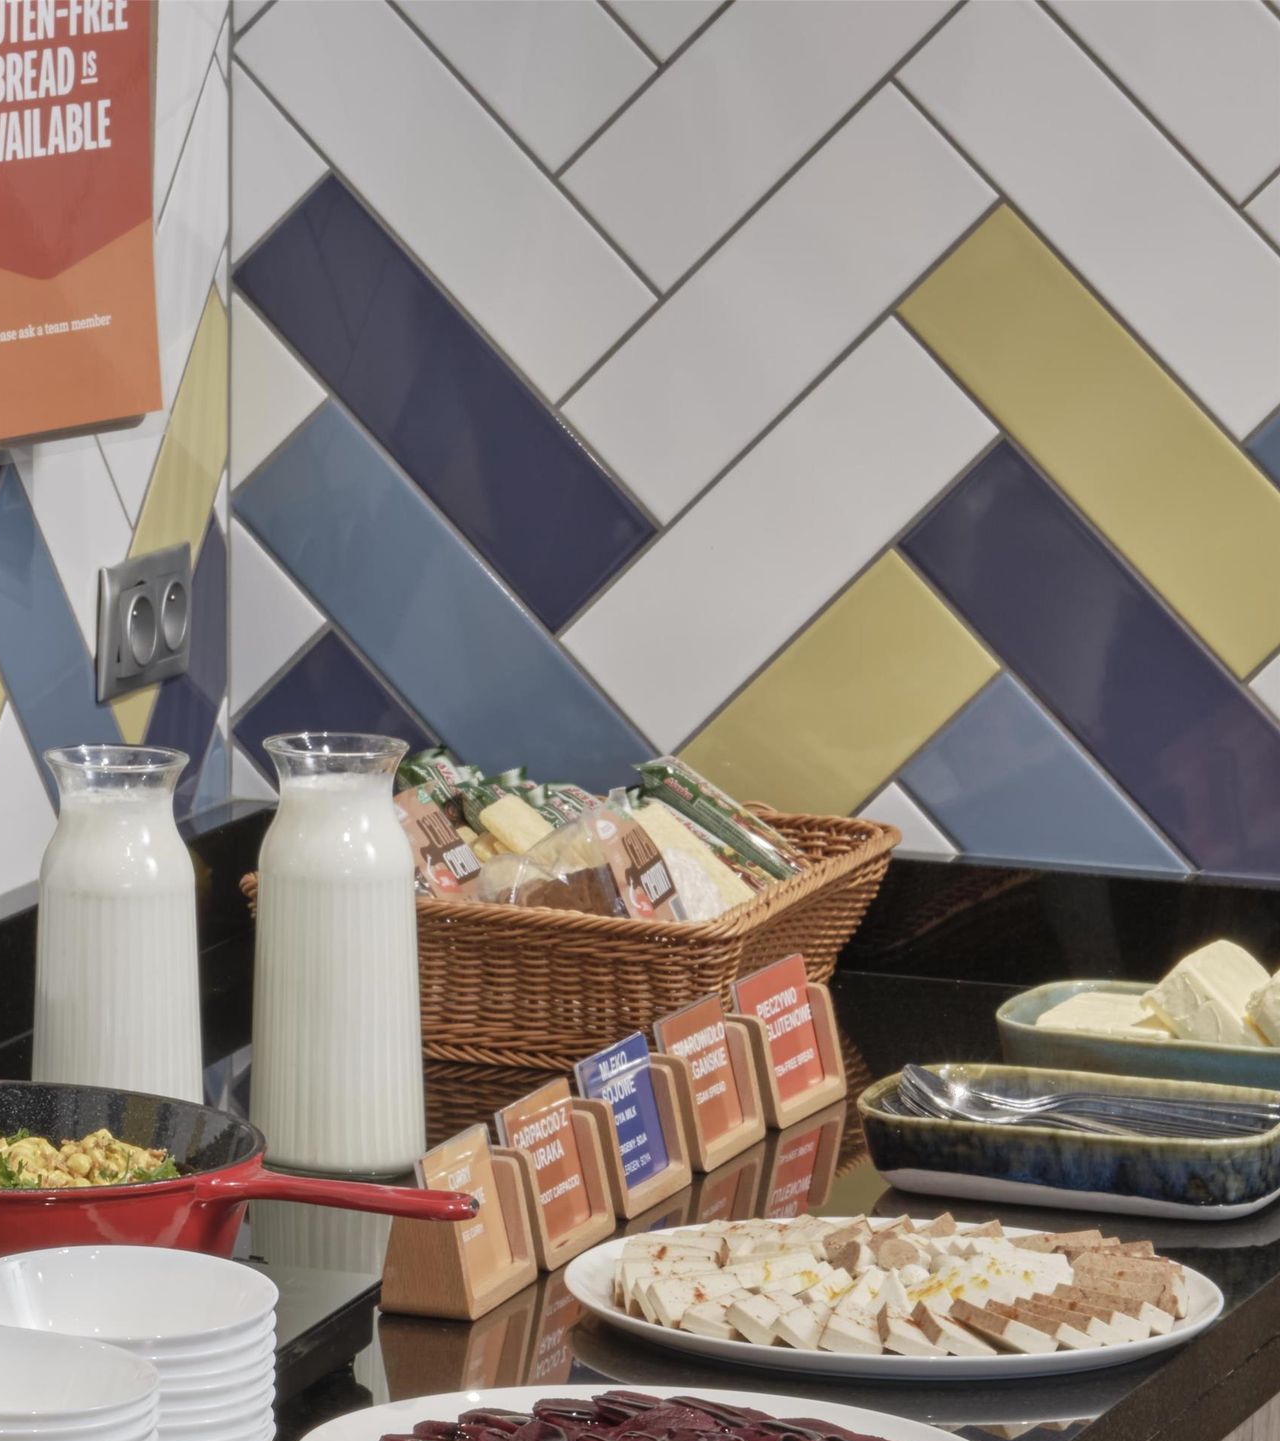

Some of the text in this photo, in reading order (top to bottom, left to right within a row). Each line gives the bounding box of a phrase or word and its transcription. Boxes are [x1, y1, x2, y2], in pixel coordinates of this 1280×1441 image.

[81, 50, 98, 84] IS
[18, 324, 36, 339] ask
[37, 325, 43, 336] a
[44, 321, 70, 335] team
[71, 313, 112, 331] member
[756, 986, 797, 1019] PIECZYWO
[766, 1003, 812, 1041] GLUTENOWE
[599, 1050, 628, 1081] MLEKO
[601, 1075, 637, 1105] SOJOWE
[513, 1106, 569, 1148] CARPACCIO Z
[532, 1138, 565, 1170] URAKA
